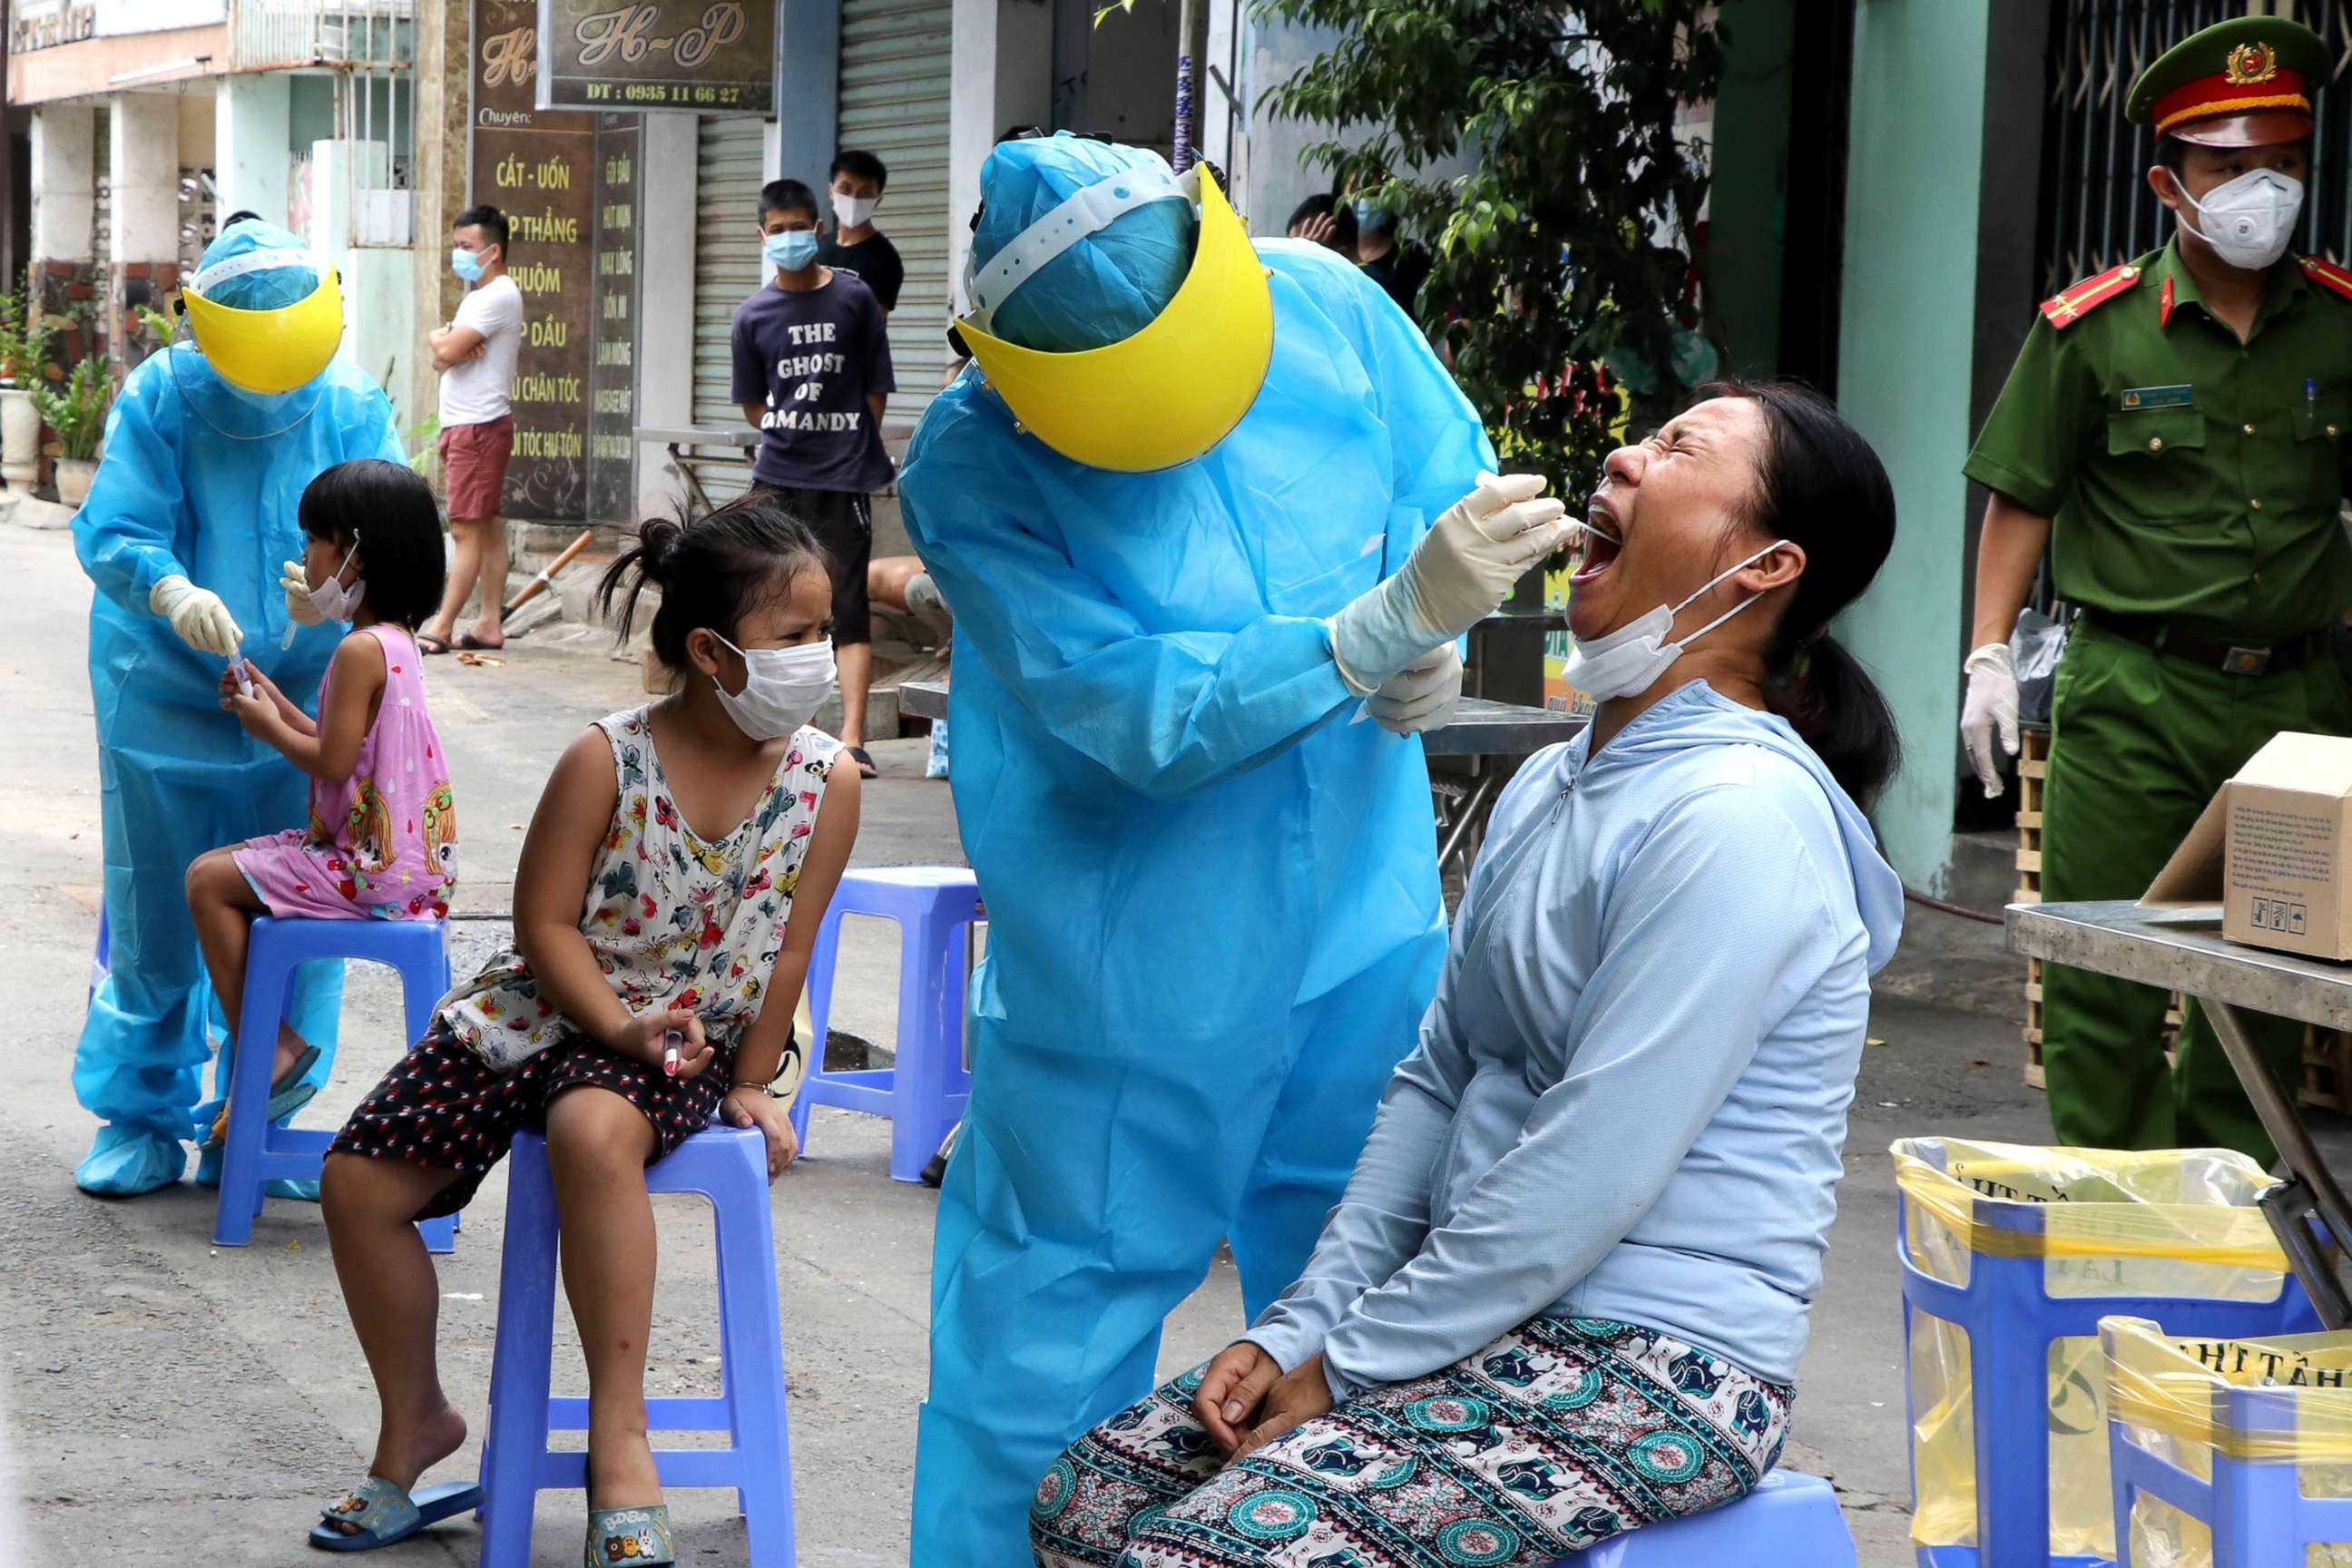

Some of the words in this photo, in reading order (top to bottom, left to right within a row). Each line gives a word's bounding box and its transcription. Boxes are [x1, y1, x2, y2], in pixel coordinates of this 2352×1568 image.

[625, 83, 665, 101] 0935
[671, 86, 690, 102] 11
[695, 86, 715, 102] 66
[720, 87, 740, 103] 27
[507, 261, 561, 297] HUỘM
[788, 323, 836, 345] THE
[778, 353, 845, 379] GHOST
[522, 370, 555, 402] CHÂN
[557, 371, 581, 403] TÓC
[794, 382, 823, 401] OF
[522, 426, 542, 456] TÓC
